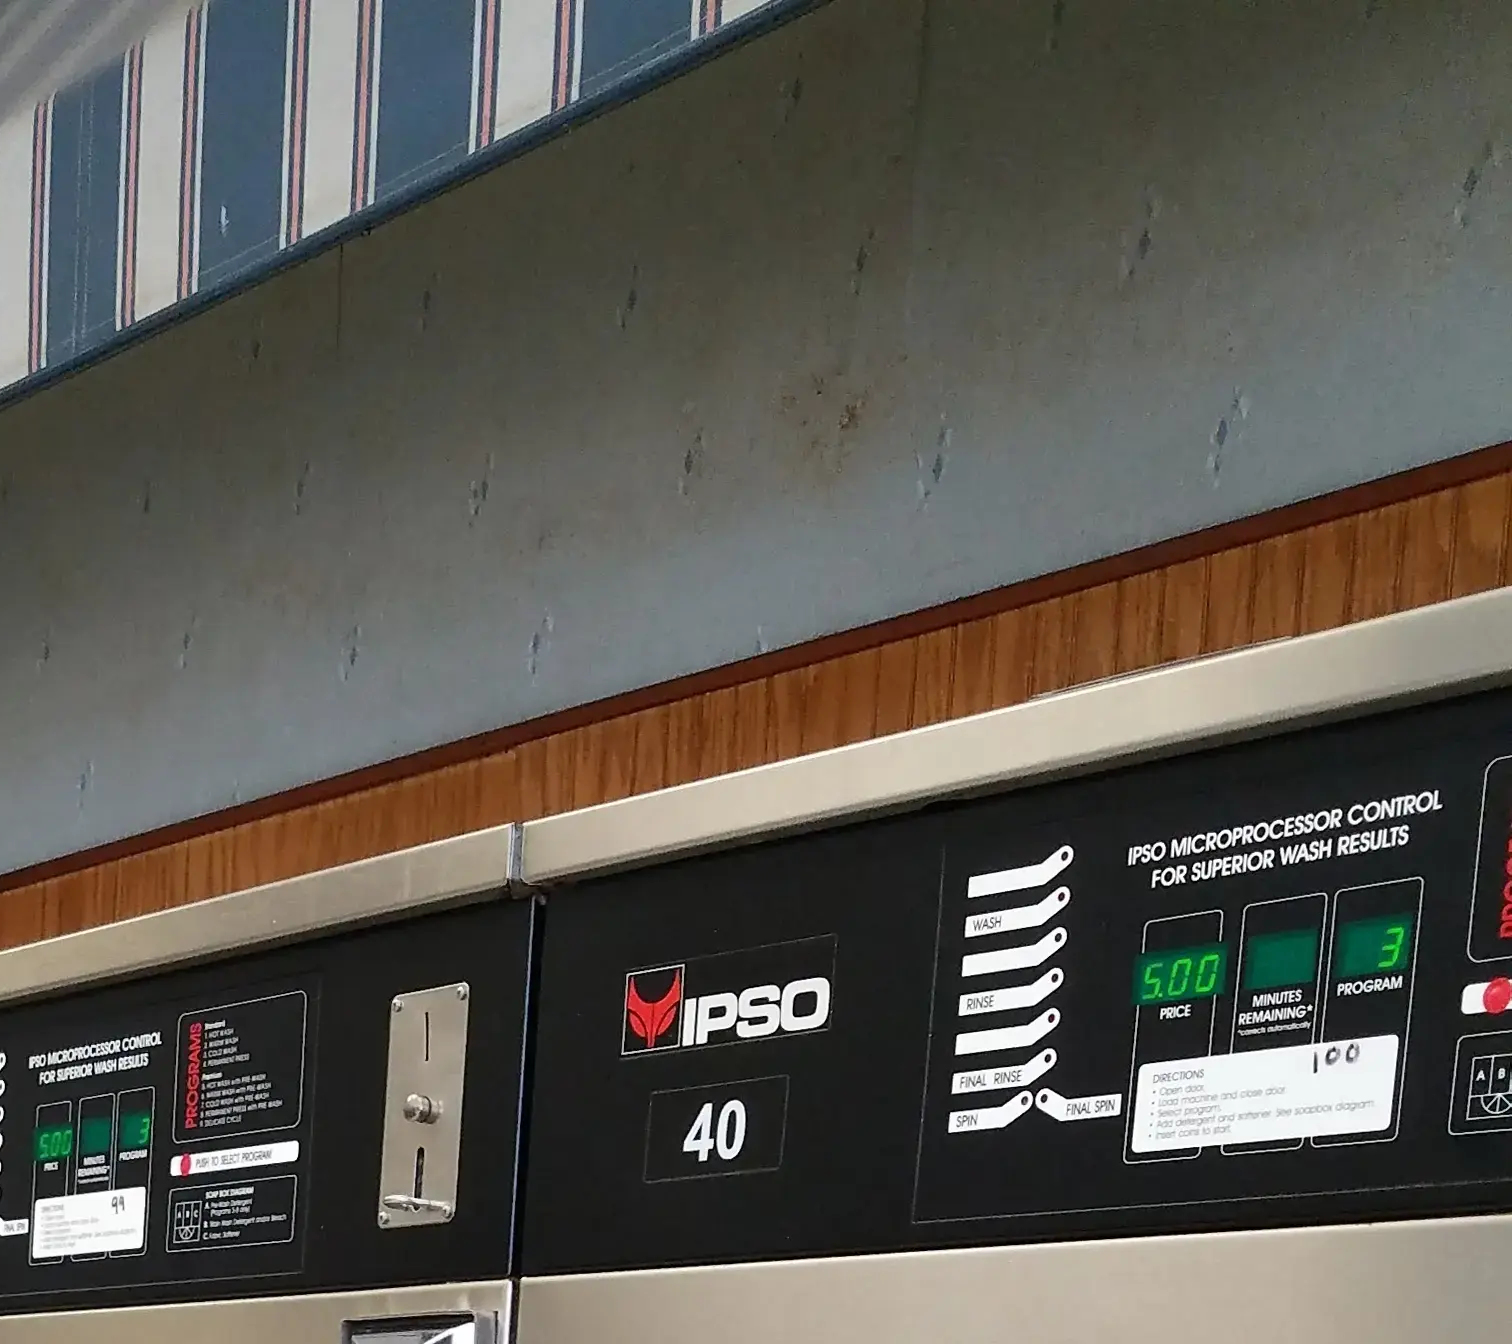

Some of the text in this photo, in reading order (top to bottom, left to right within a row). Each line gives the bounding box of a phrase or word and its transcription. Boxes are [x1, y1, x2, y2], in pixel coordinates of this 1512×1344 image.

[1127, 790, 1443, 866] IPSO MICROPROCESSOR CONTROL
[1151, 824, 1411, 889] FOR SUPERIOR WASH RESULTS
[973, 916, 1002, 932] WASH
[1377, 926, 1405, 969] 3
[1141, 954, 1220, 1000] 5.00
[1336, 975, 1404, 997] PROGRAM
[966, 994, 995, 1010] RINSE
[1252, 989, 1303, 1008] MINUTES
[682, 976, 831, 1047] IPSO
[1159, 1004, 1192, 1020] PRICE
[28, 1031, 163, 1069] IPSO MICROPROCESSOR CONTROL
[39, 1052, 149, 1085] FOR SUPERIOR WASH RESULTS
[185, 1022, 202, 1129] PROGRAMS
[959, 1069, 1023, 1089] FINAL RINSE
[1152, 1068, 1205, 1084] DIRECTIONS
[1476, 1067, 1506, 1082] A B
[1065, 1097, 1116, 1117] FINAL SPIN
[138, 1117, 150, 1144] 3
[682, 1098, 747, 1163] 40
[956, 1112, 979, 1129] SPIN
[211, 1155, 219, 1166] TO
[241, 1149, 273, 1162] PROGRAM
